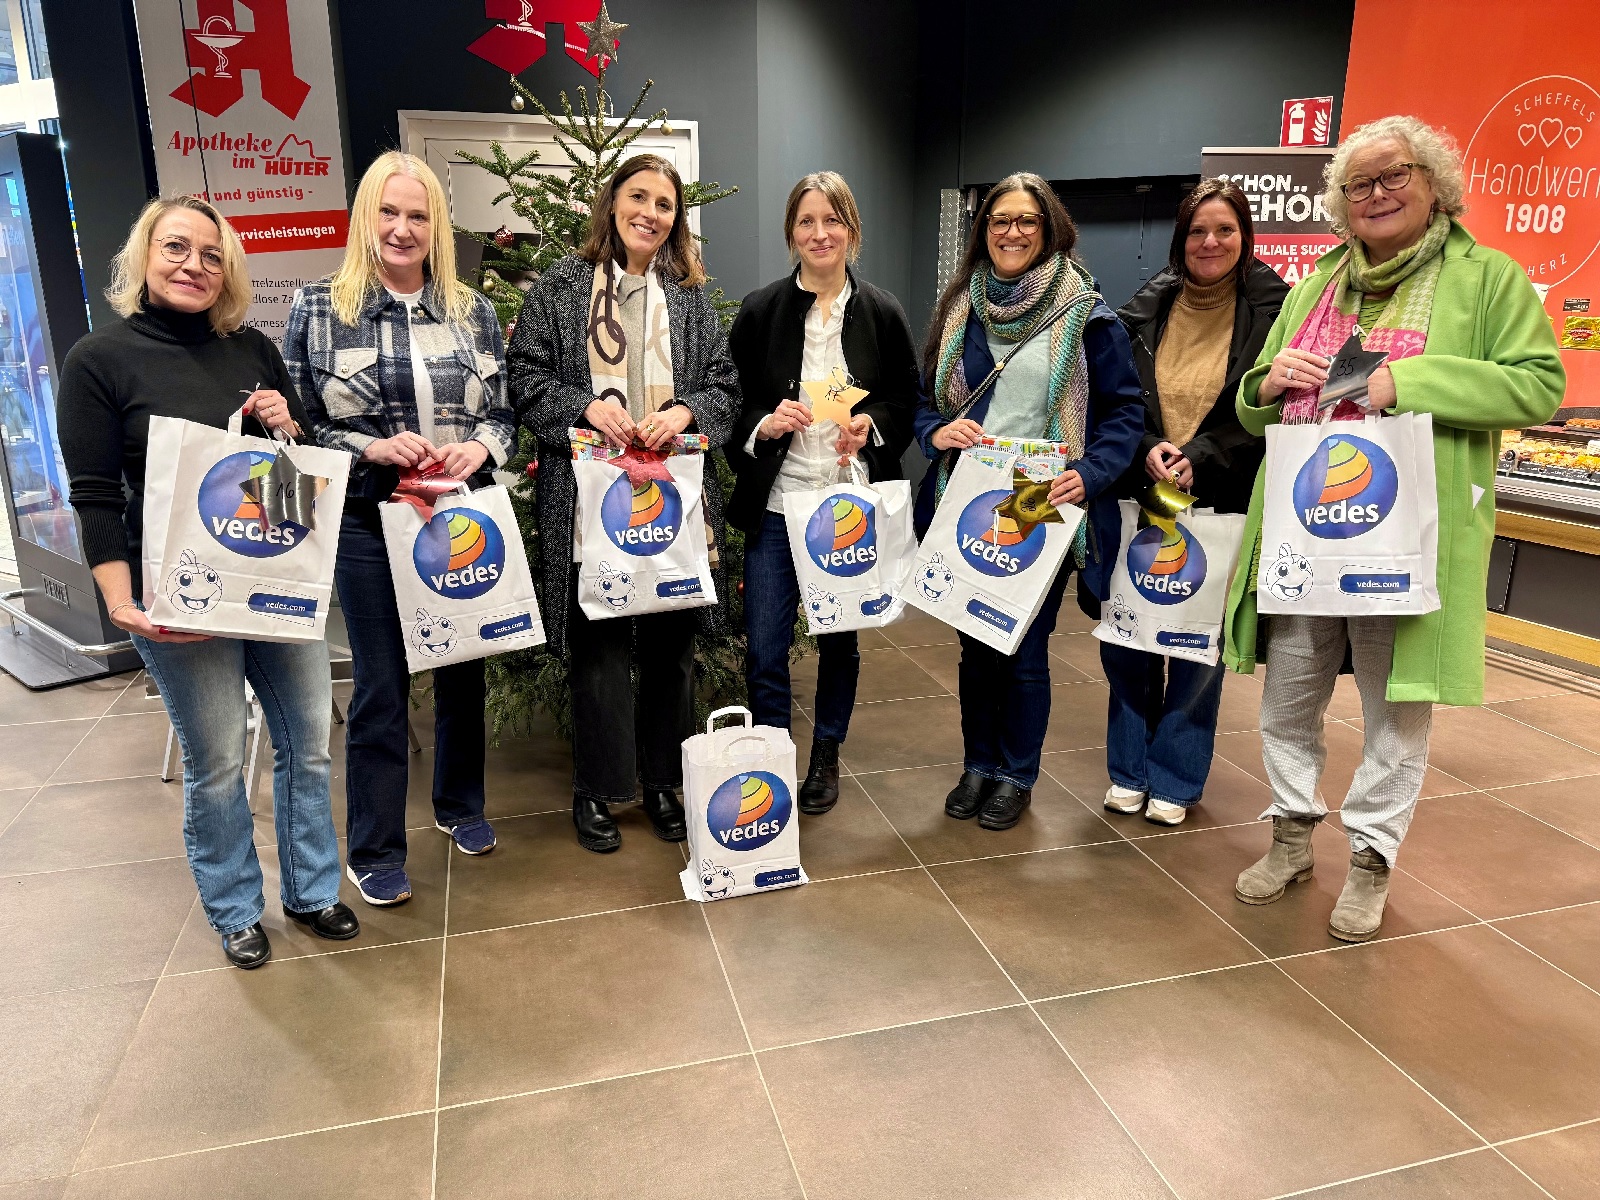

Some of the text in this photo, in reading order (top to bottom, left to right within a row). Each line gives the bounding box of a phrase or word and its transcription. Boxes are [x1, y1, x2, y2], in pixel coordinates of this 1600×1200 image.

[1514, 93, 1595, 122] SCHEFFELS
[167, 130, 273, 156] Apotheke
[232, 153, 329, 176] im HÜTER
[1468, 156, 1600, 198] Handwer
[190, 190, 210, 201] ut
[214, 189, 242, 201] und
[247, 186, 304, 202] günstig
[1505, 203, 1566, 234] 1908
[235, 225, 336, 241] erviceleistungen
[1253, 244, 1298, 256] FILIALE
[1527, 253, 1567, 277] HERZ
[253, 294, 294, 304] dlose Za
[1337, 356, 1358, 377] 35
[275, 482, 295, 499] 16
[1304, 500, 1380, 526] vedes
[614, 524, 674, 546] vedes
[818, 545, 877, 570] vedes
[961, 533, 1021, 574] vedes
[430, 563, 499, 591] vedes
[1134, 570, 1192, 596] vedes
[1356, 580, 1400, 589] vedes.com
[265, 600, 306, 613] vedes.com
[978, 607, 1009, 627] vedes.com
[493, 621, 524, 634] vedes.com
[1169, 636, 1201, 646] vedes.com
[718, 819, 780, 844] vedes
